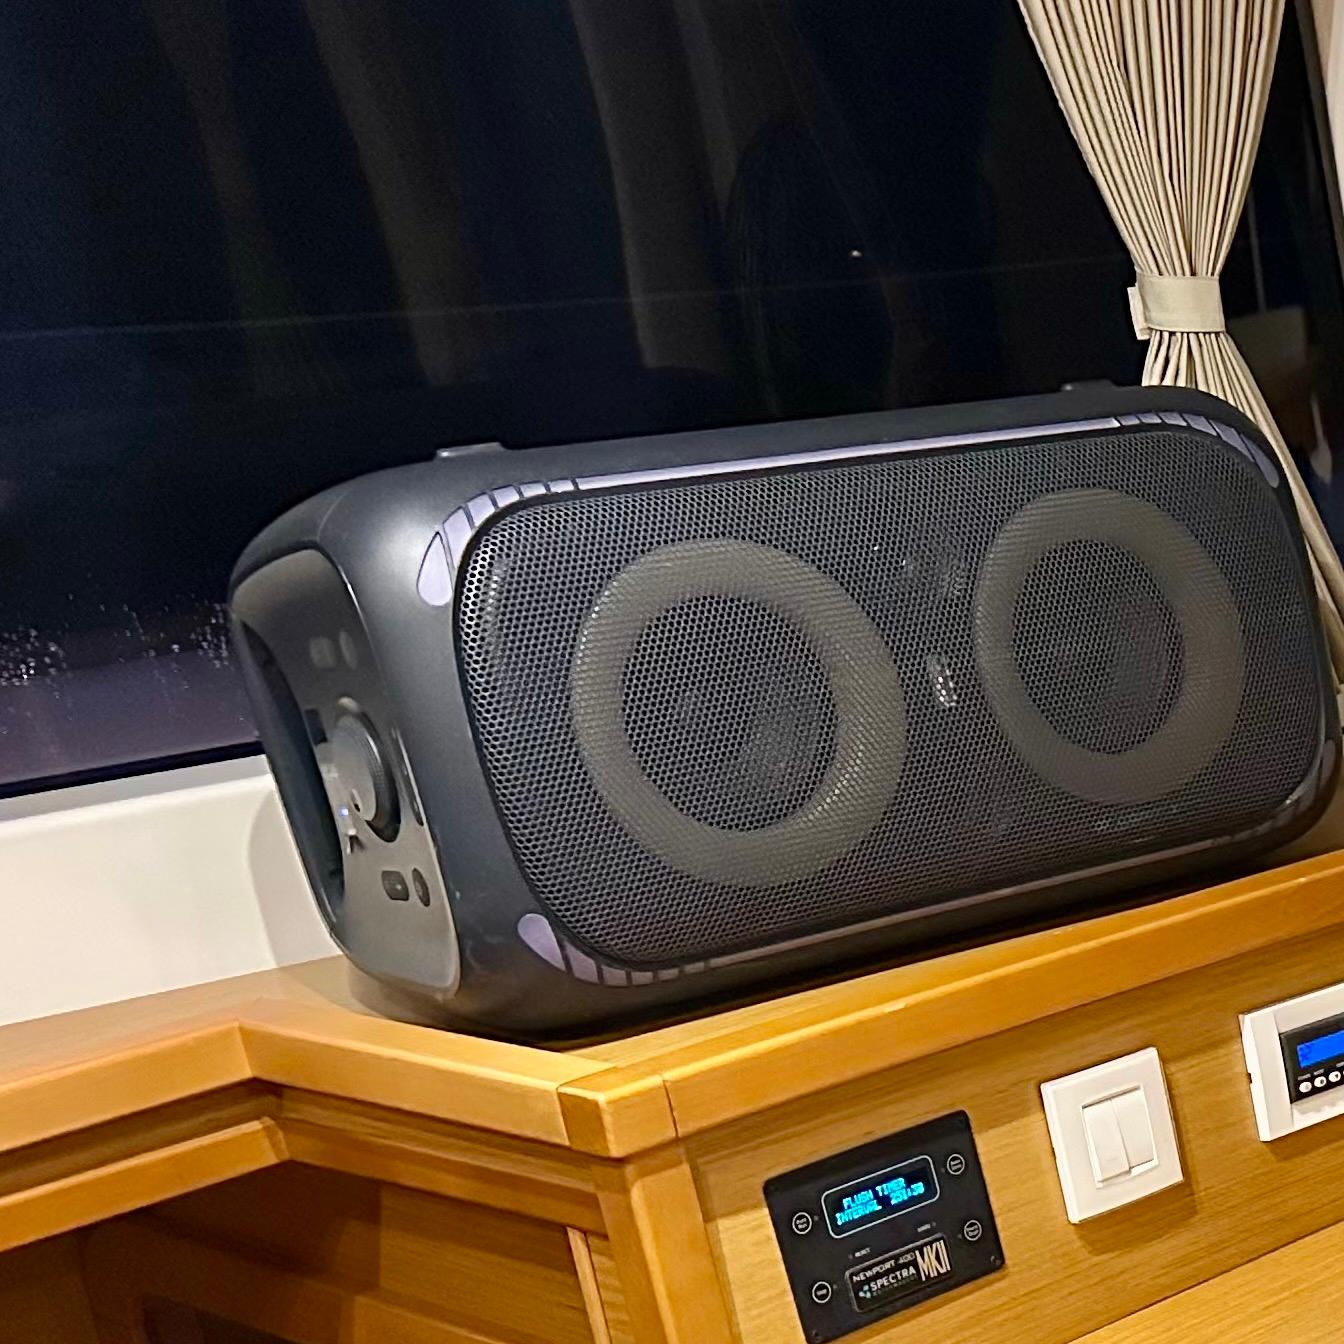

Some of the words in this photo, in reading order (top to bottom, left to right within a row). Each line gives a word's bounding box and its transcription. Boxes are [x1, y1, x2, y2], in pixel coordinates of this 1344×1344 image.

[843, 1189, 874, 1210] FLUSH
[876, 1177, 906, 1196] TIMER
[835, 1200, 882, 1225] INTERVAL
[853, 1260, 896, 1283] NEWPORT
[915, 1239, 951, 1281] MKII
[870, 1266, 917, 1291] SPECTRA
